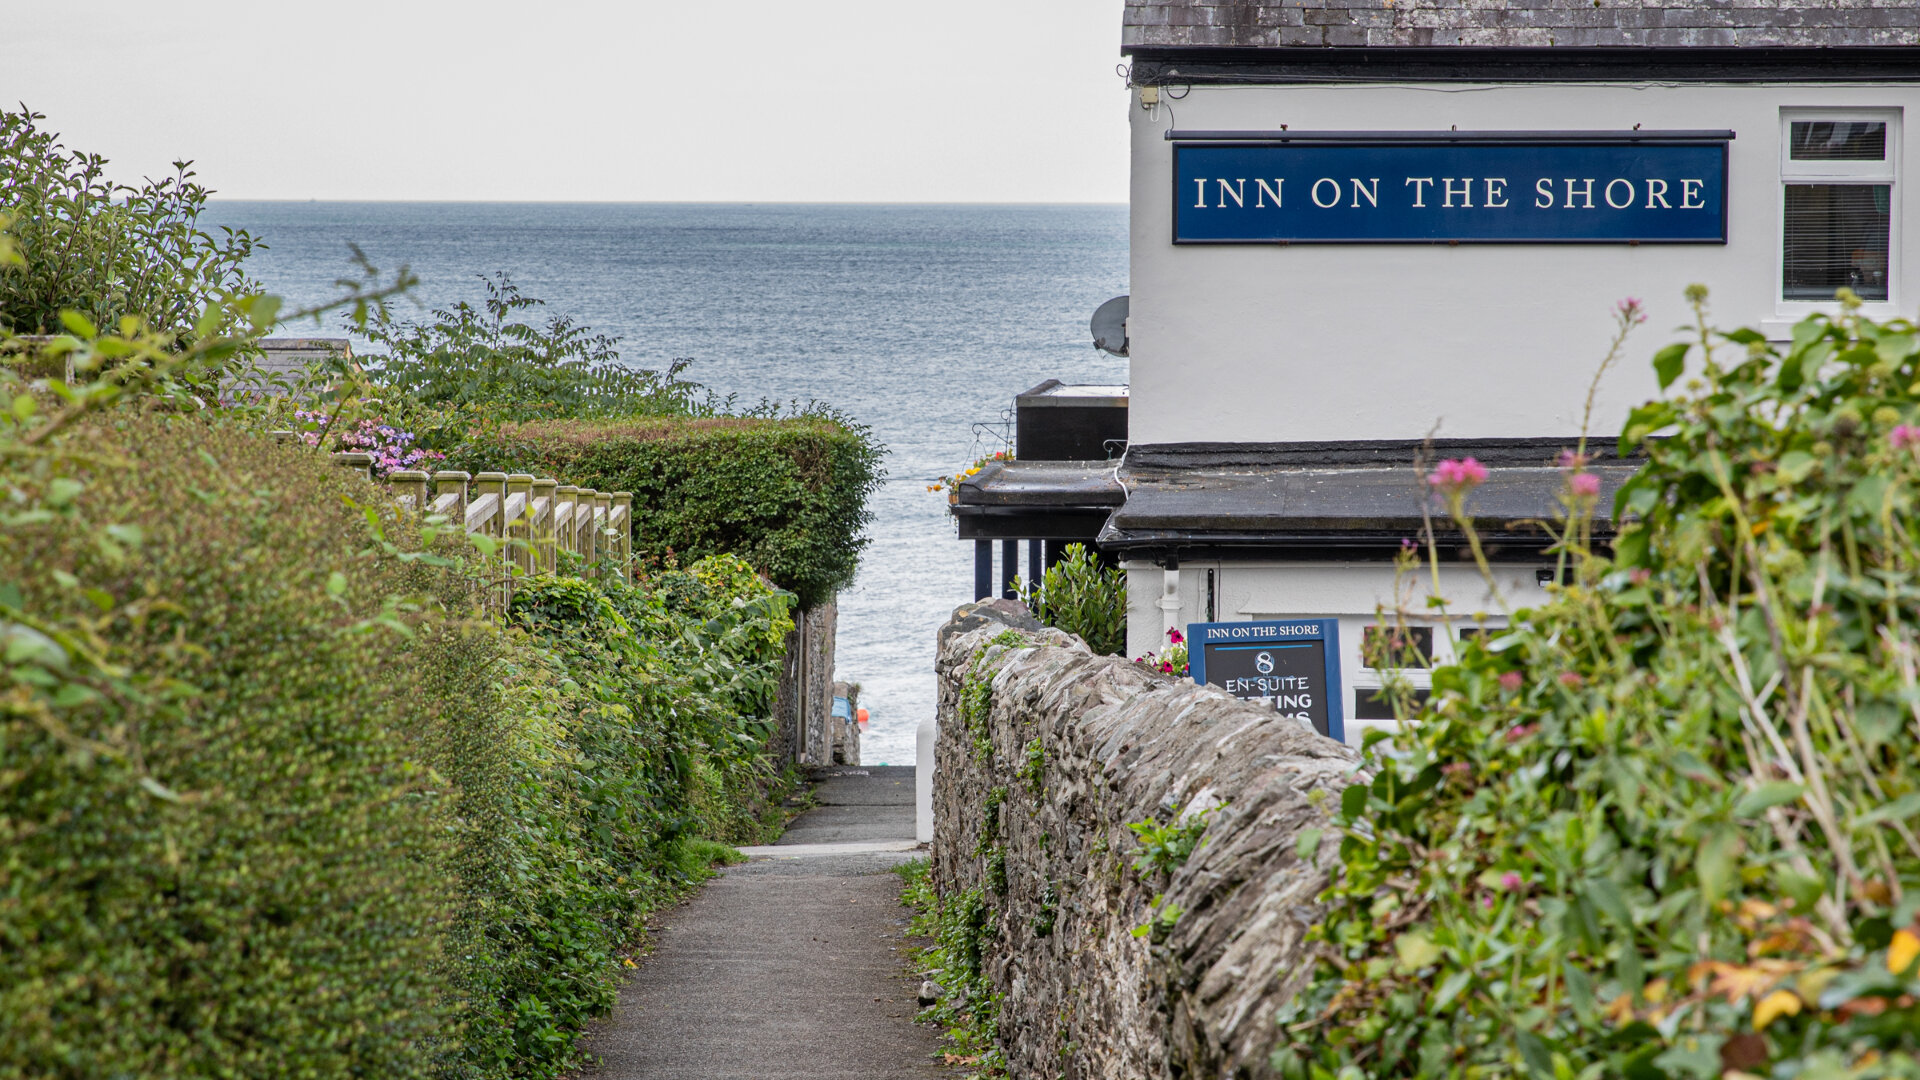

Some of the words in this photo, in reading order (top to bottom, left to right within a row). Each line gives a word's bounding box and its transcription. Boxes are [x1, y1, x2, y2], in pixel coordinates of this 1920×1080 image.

[1193, 178, 1285, 208] INN
[1310, 177, 1380, 208] ON
[1405, 177, 1509, 208] THE
[1535, 177, 1705, 209] SHORE
[1207, 628, 1229, 639] INN
[1231, 627, 1250, 638] ON
[1251, 626, 1278, 637] THE
[1279, 624, 1320, 636] SHORE
[1256, 652, 1274, 674] 8
[1225, 676, 1310, 693] EN-SUITE
